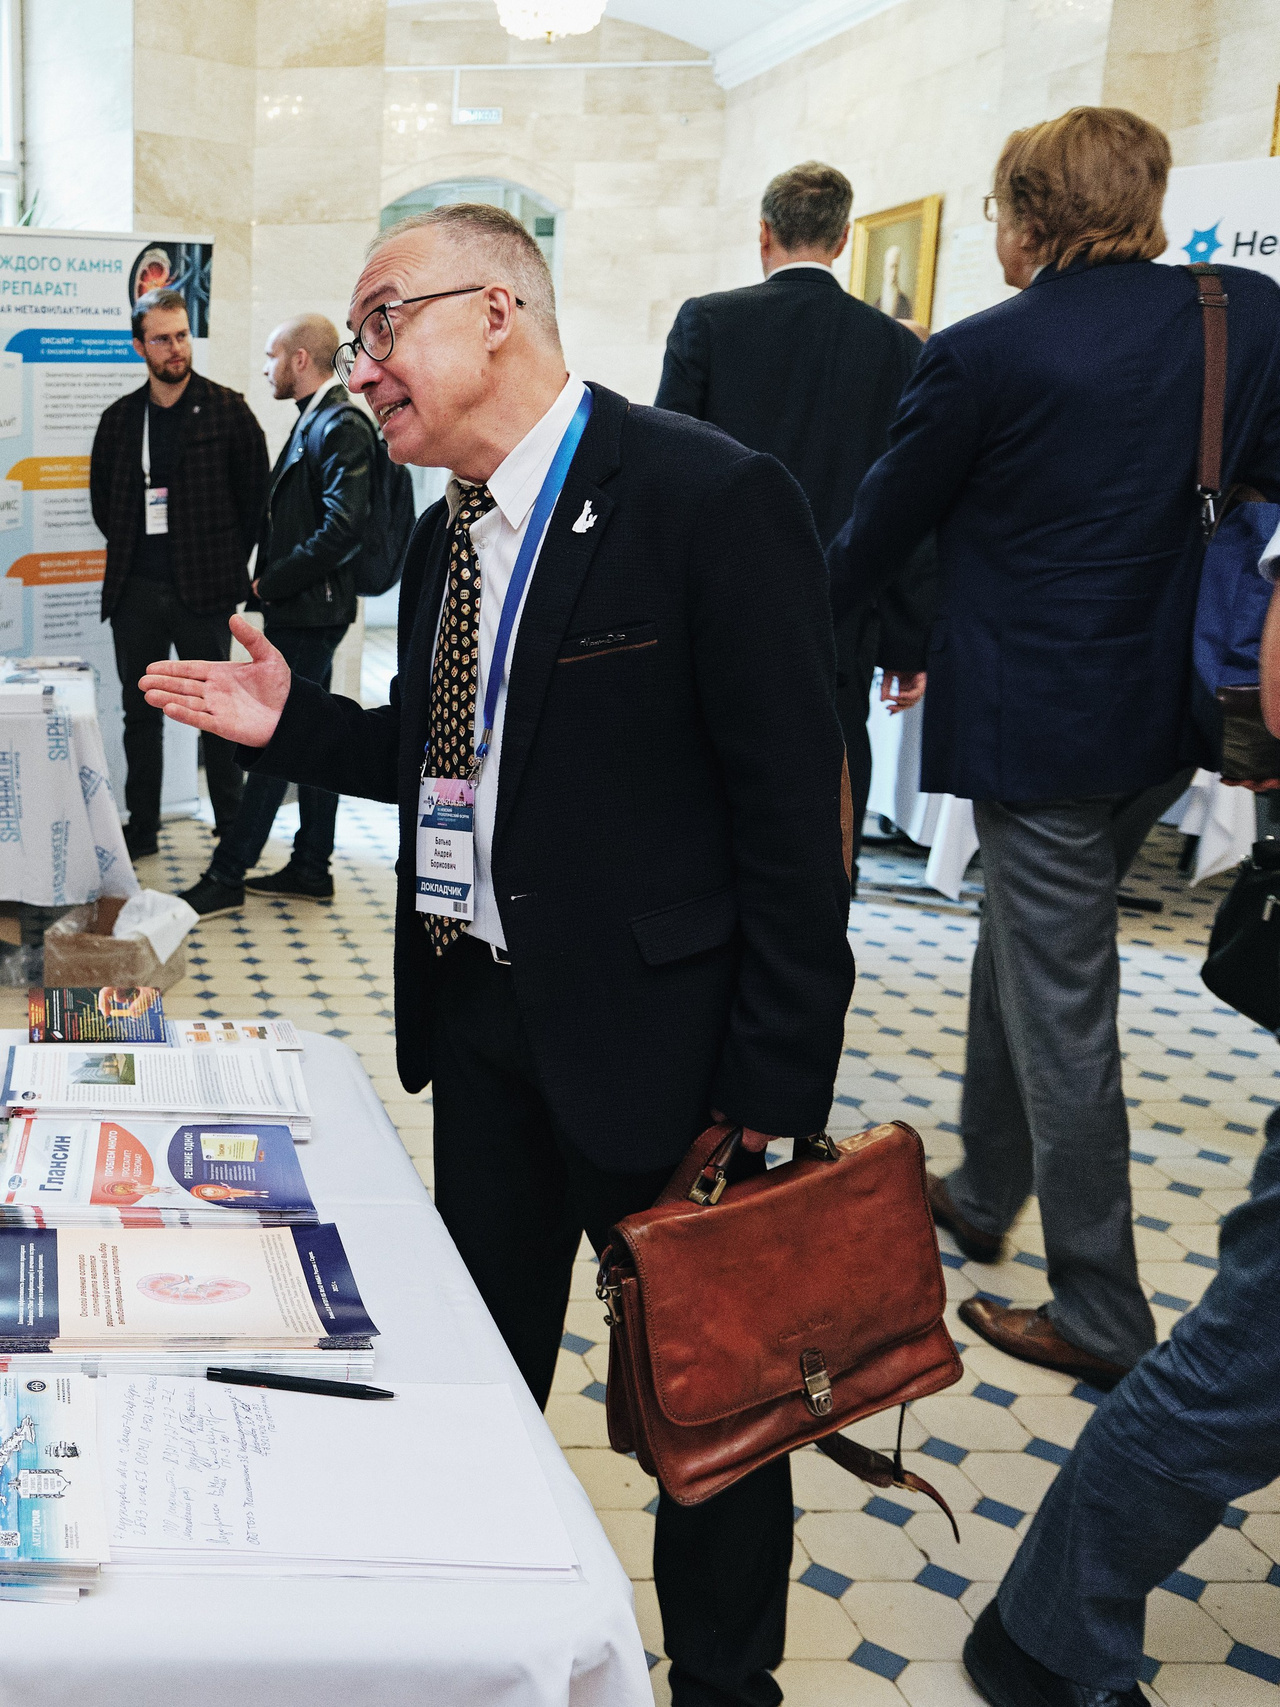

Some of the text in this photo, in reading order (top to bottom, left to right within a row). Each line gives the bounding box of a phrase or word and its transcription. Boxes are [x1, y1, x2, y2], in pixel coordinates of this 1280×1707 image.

[67, 258, 124, 274] КАМНЯ
[434, 848, 452, 860] Андрей
[430, 859, 456, 870] Борисович
[421, 881, 462, 897] ДОКЛАДЧИК
[39, 1135, 71, 1192] Глансин
[184, 1132, 194, 1180] РЕШЕНИЕ ОДНО!
[98, 1243, 108, 1259] выбор
[111, 1245, 120, 1275] препаратов
[79, 1254, 87, 1276] острого
[100, 1259, 110, 1290] осознанный
[80, 1298, 89, 1317] Основой
[91, 1281, 100, 1316] пиелонефрита
